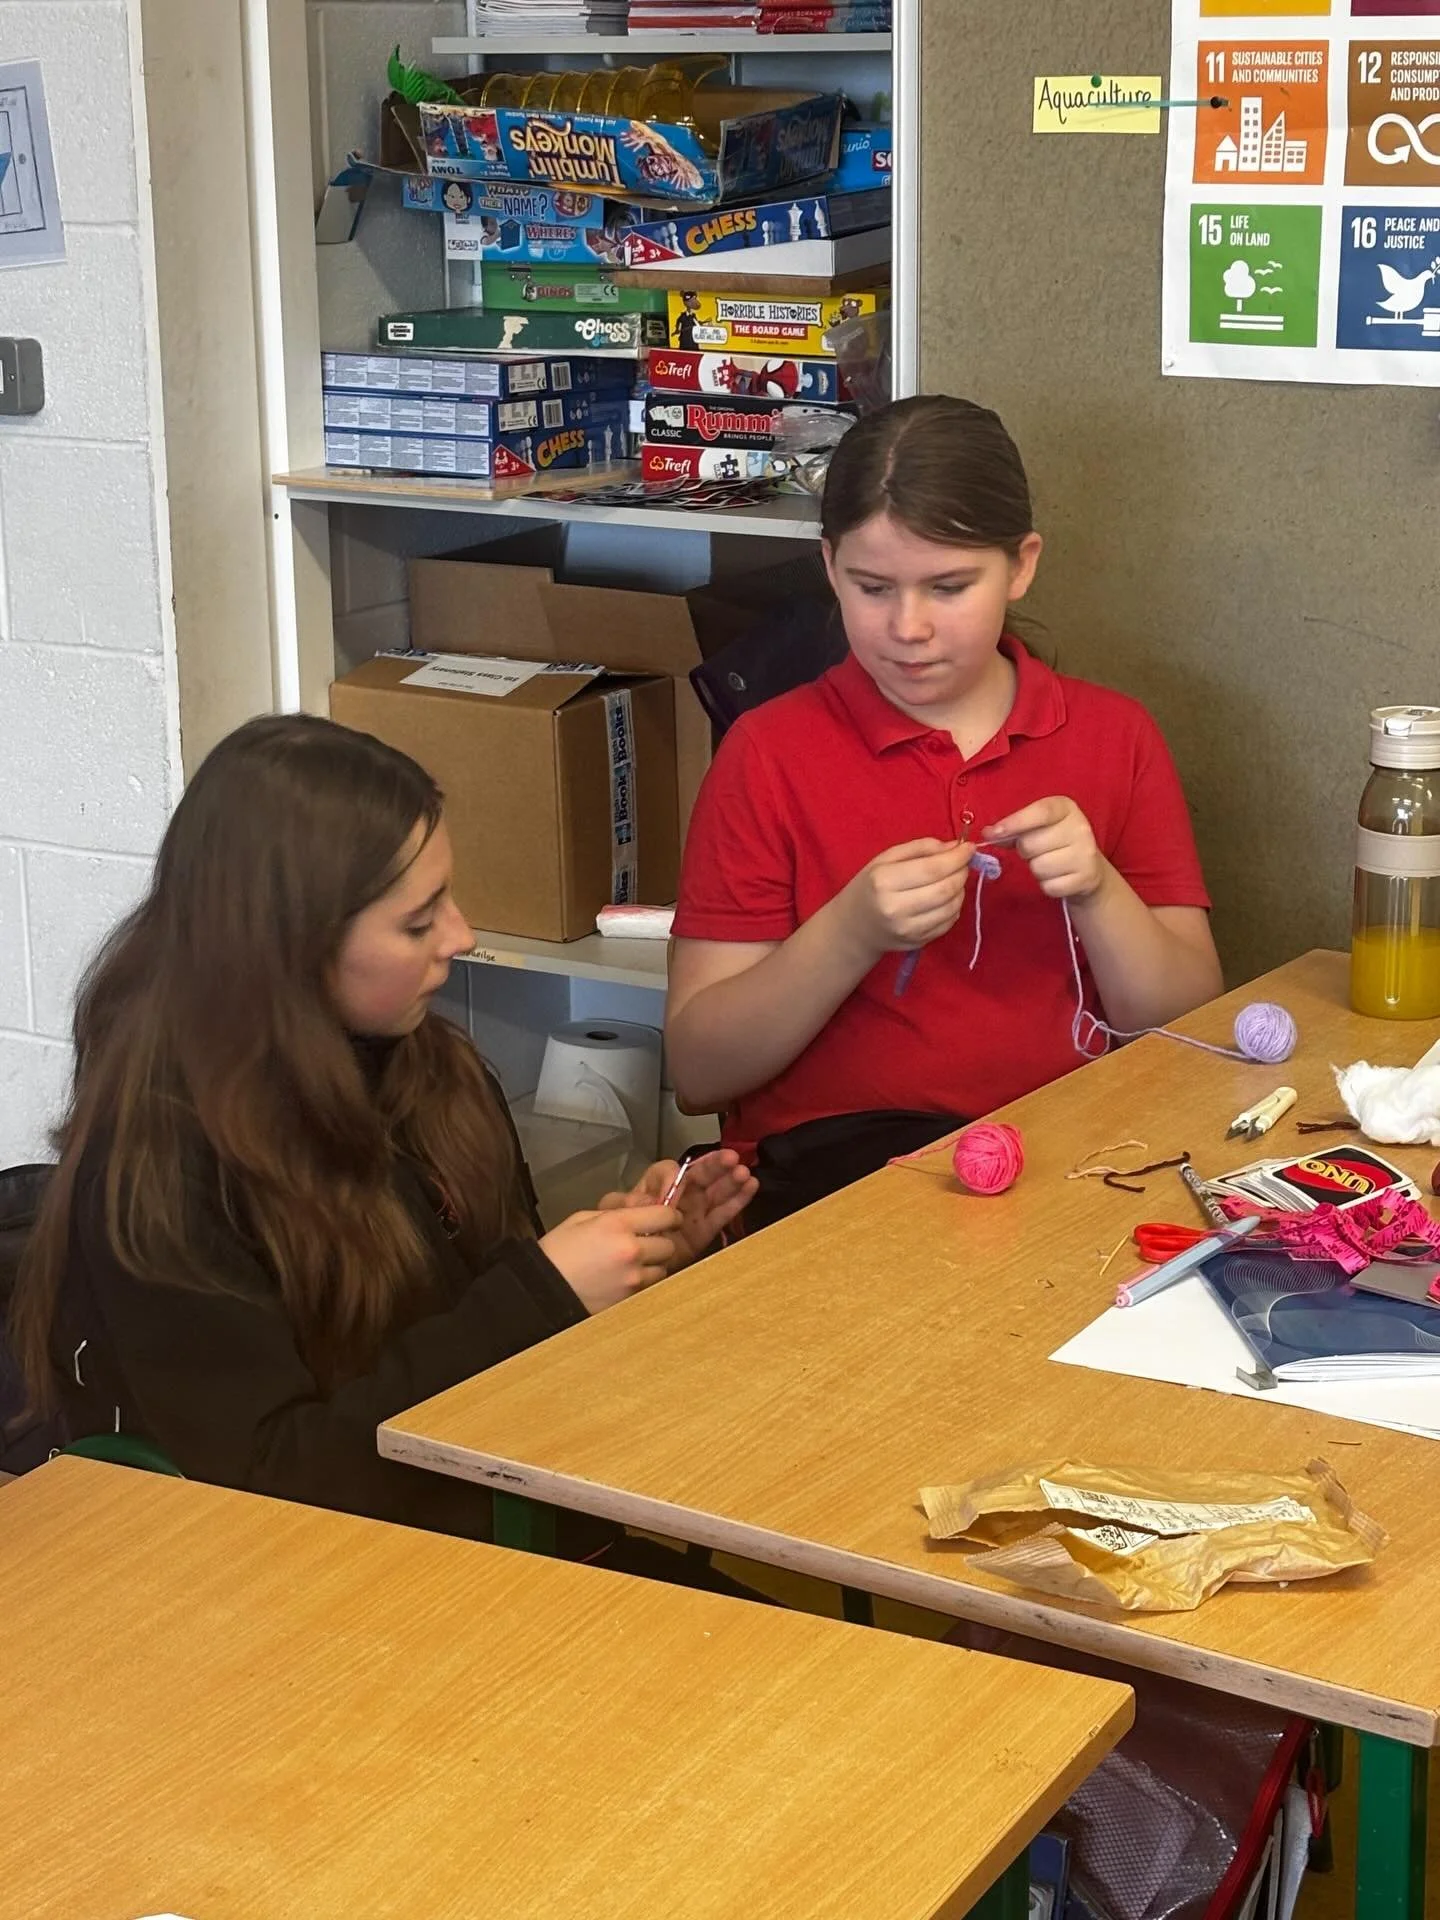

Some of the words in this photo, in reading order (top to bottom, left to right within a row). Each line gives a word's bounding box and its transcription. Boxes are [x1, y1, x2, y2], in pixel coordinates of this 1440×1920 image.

[1205, 51, 1225, 83] 11
[1232, 51, 1293, 66] SUSTAINABLE
[1294, 51, 1323, 66] CITIES
[1231, 68, 1252, 83] AND
[1252, 68, 1319, 83] COMMUNITIES
[1357, 51, 1382, 84] 12
[1038, 79, 1153, 124] Aquaculture
[1389, 87, 1411, 101] AND
[1412, 87, 1440, 101] PROD
[509, 120, 617, 160] Monkeys
[431, 165, 464, 175] TOMY
[504, 193, 548, 220] NAME?
[1198, 215, 1222, 246] 15
[1230, 215, 1249, 229] LIFE
[1384, 217, 1416, 232] PEACE
[1418, 218, 1440, 232] AND
[686, 208, 757, 255] CHESS
[1229, 232, 1244, 247] ON
[1244, 232, 1271, 247] LAND
[1351, 216, 1377, 249] 16
[1383, 235, 1426, 249] JUSTICE
[720, 302, 766, 320] HORRIBLE
[768, 304, 818, 322] HISTORIES
[574, 318, 631, 343] Chess
[734, 324, 751, 335] THE
[752, 325, 779, 336] BOARD
[780, 326, 805, 337] GAME
[667, 361, 692, 378] Trefl
[650, 428, 682, 439] CLASSIC
[723, 432, 748, 441] BRINGS
[749, 434, 773, 442] PEOPLE
[537, 429, 585, 468] CHESS
[664, 457, 691, 473] Trefl
[1298, 1159, 1376, 1195] UNO
